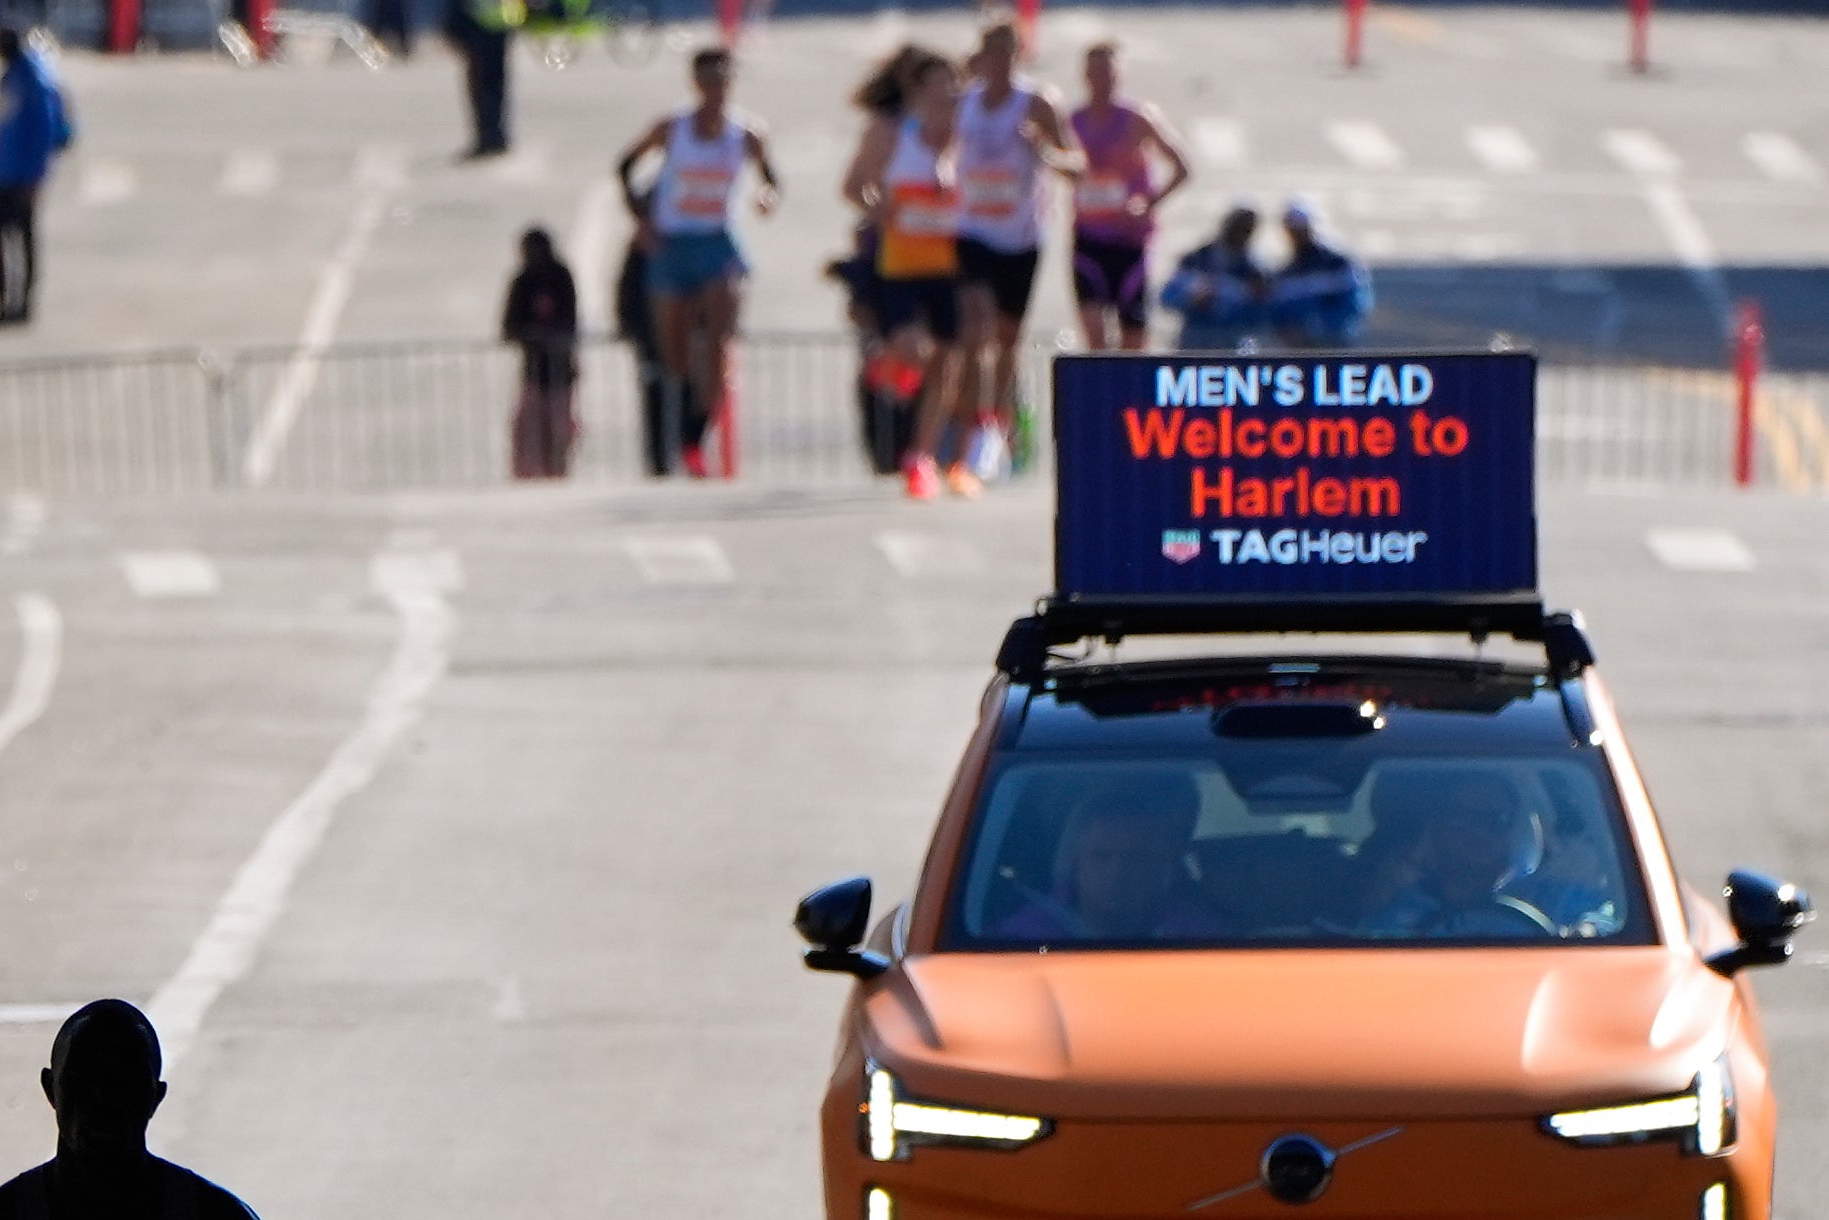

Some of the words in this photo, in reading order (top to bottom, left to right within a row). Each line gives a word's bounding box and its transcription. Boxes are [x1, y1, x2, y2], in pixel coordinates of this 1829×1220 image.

[1155, 364, 1305, 407] MEN'S
[1313, 364, 1434, 407] LEAD
[1122, 407, 1397, 459] Welcome
[1409, 409, 1469, 457] to
[1190, 466, 1402, 518] Harlem
